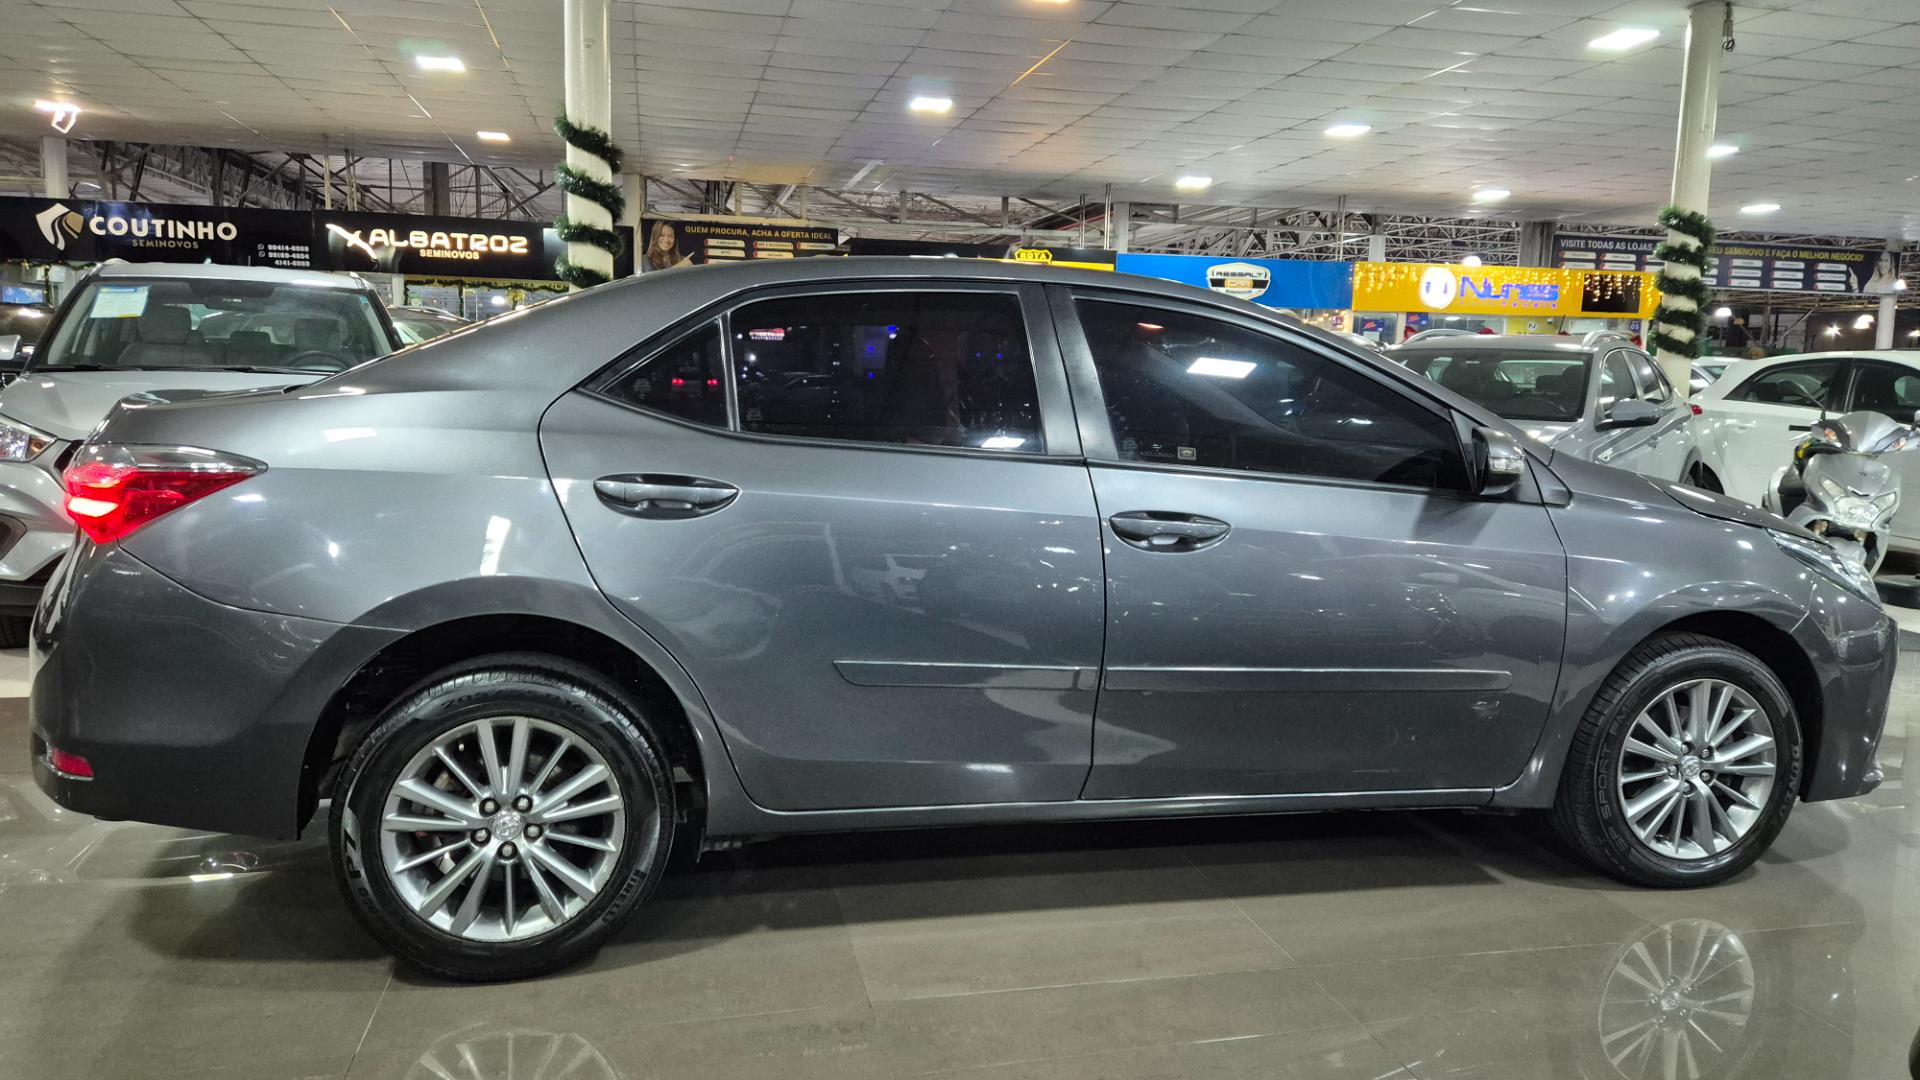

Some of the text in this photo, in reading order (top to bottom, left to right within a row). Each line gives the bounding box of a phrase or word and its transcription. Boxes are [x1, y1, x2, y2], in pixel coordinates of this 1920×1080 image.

[89, 216, 238, 241] COUTINHO
[710, 227, 749, 237] PROCURA,
[752, 229, 772, 237] ACHA
[774, 230, 780, 238] A
[781, 230, 809, 239] OFERTA
[811, 232, 832, 240] IDEAL
[132, 239, 199, 249] SEMINOVOS
[369, 228, 529, 254] ALBATROZ
[1560, 239, 1653, 251] VISITE TODAS AS LOJAS
[419, 249, 480, 260] SEMINOVOS
[1771, 249, 1791, 259] FAÇA
[1792, 250, 1798, 258] O
[1799, 250, 1829, 259] MELHOR
[1597, 745, 1612, 820] SPORT
[1608, 827, 1628, 851] SP
